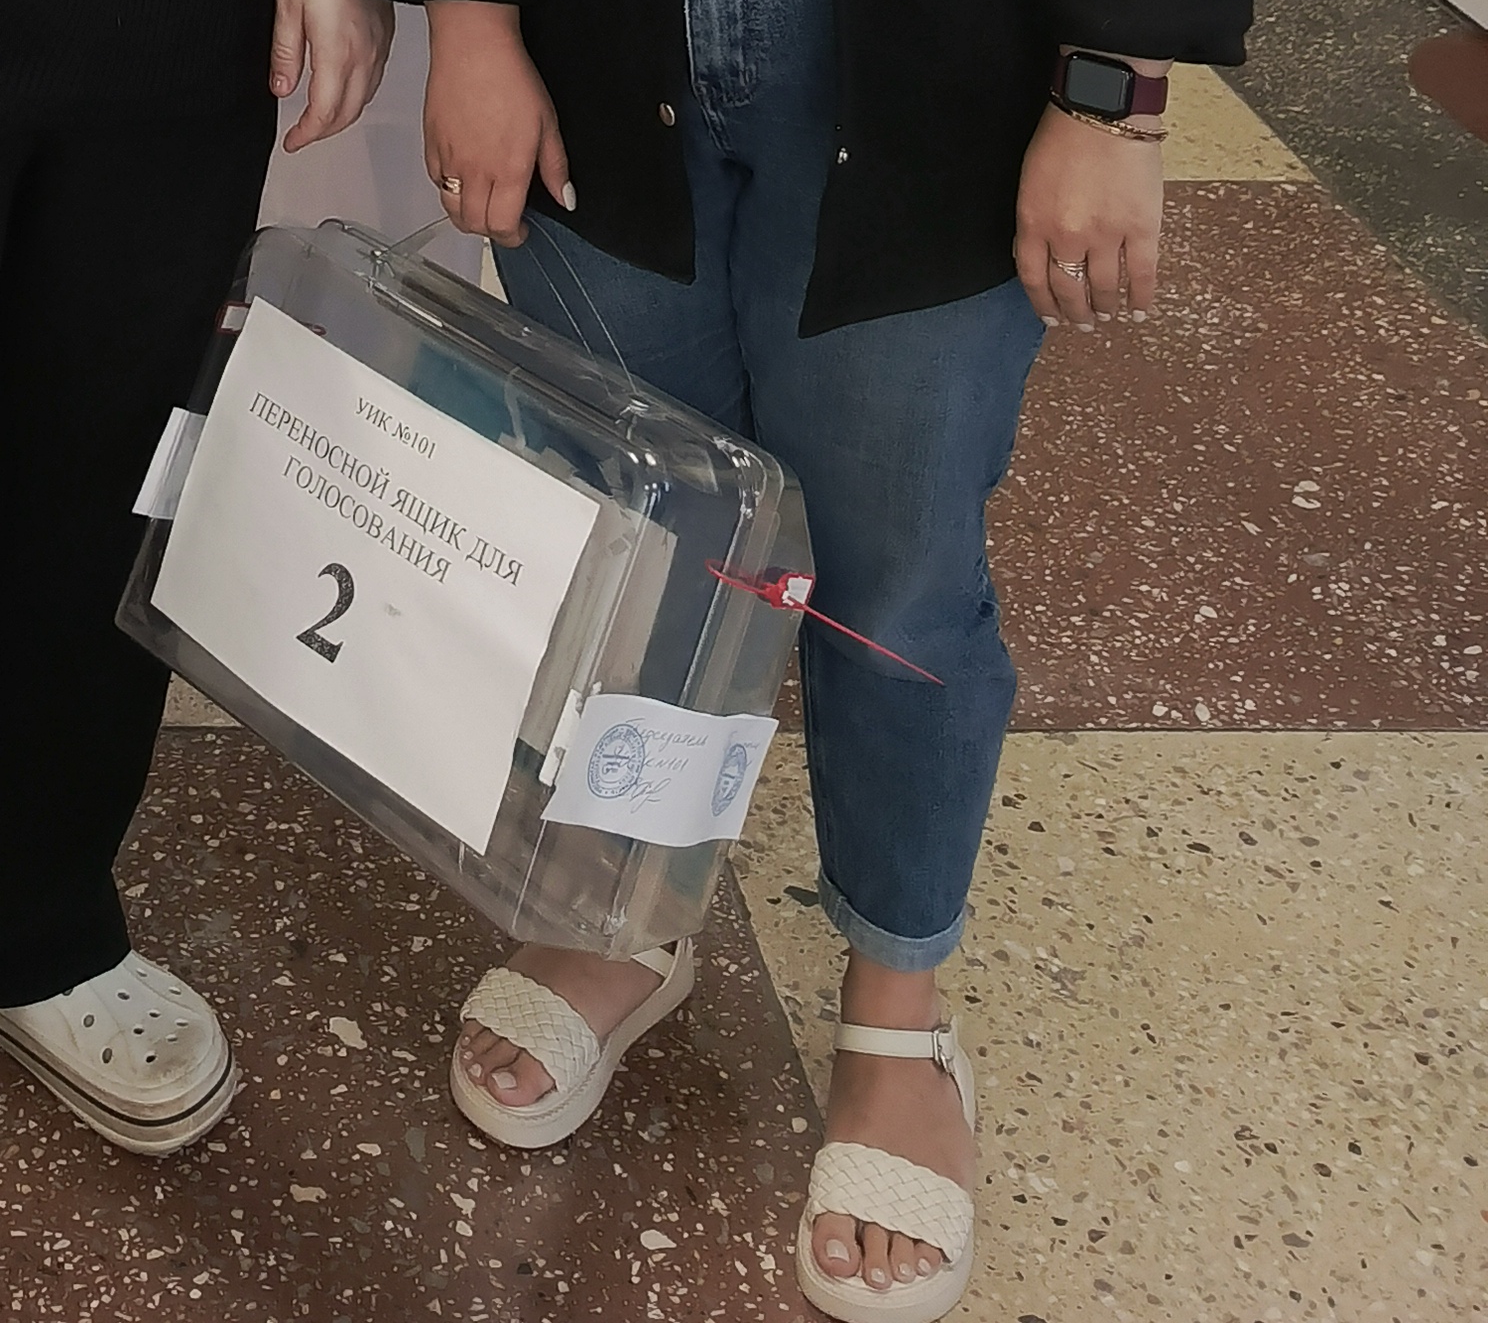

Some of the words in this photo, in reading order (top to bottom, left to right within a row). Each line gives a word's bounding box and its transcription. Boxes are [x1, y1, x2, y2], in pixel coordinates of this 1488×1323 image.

[355, 397, 394, 433] УИК
[393, 425, 437, 460] №101
[248, 392, 391, 500] ПЕРЕНОСНОЙ
[390, 489, 468, 552] ЯЩИК
[465, 536, 525, 587] ДЛЯ
[281, 455, 453, 584] ГОЛОСОВАНИЯ
[295, 562, 355, 663] 2
